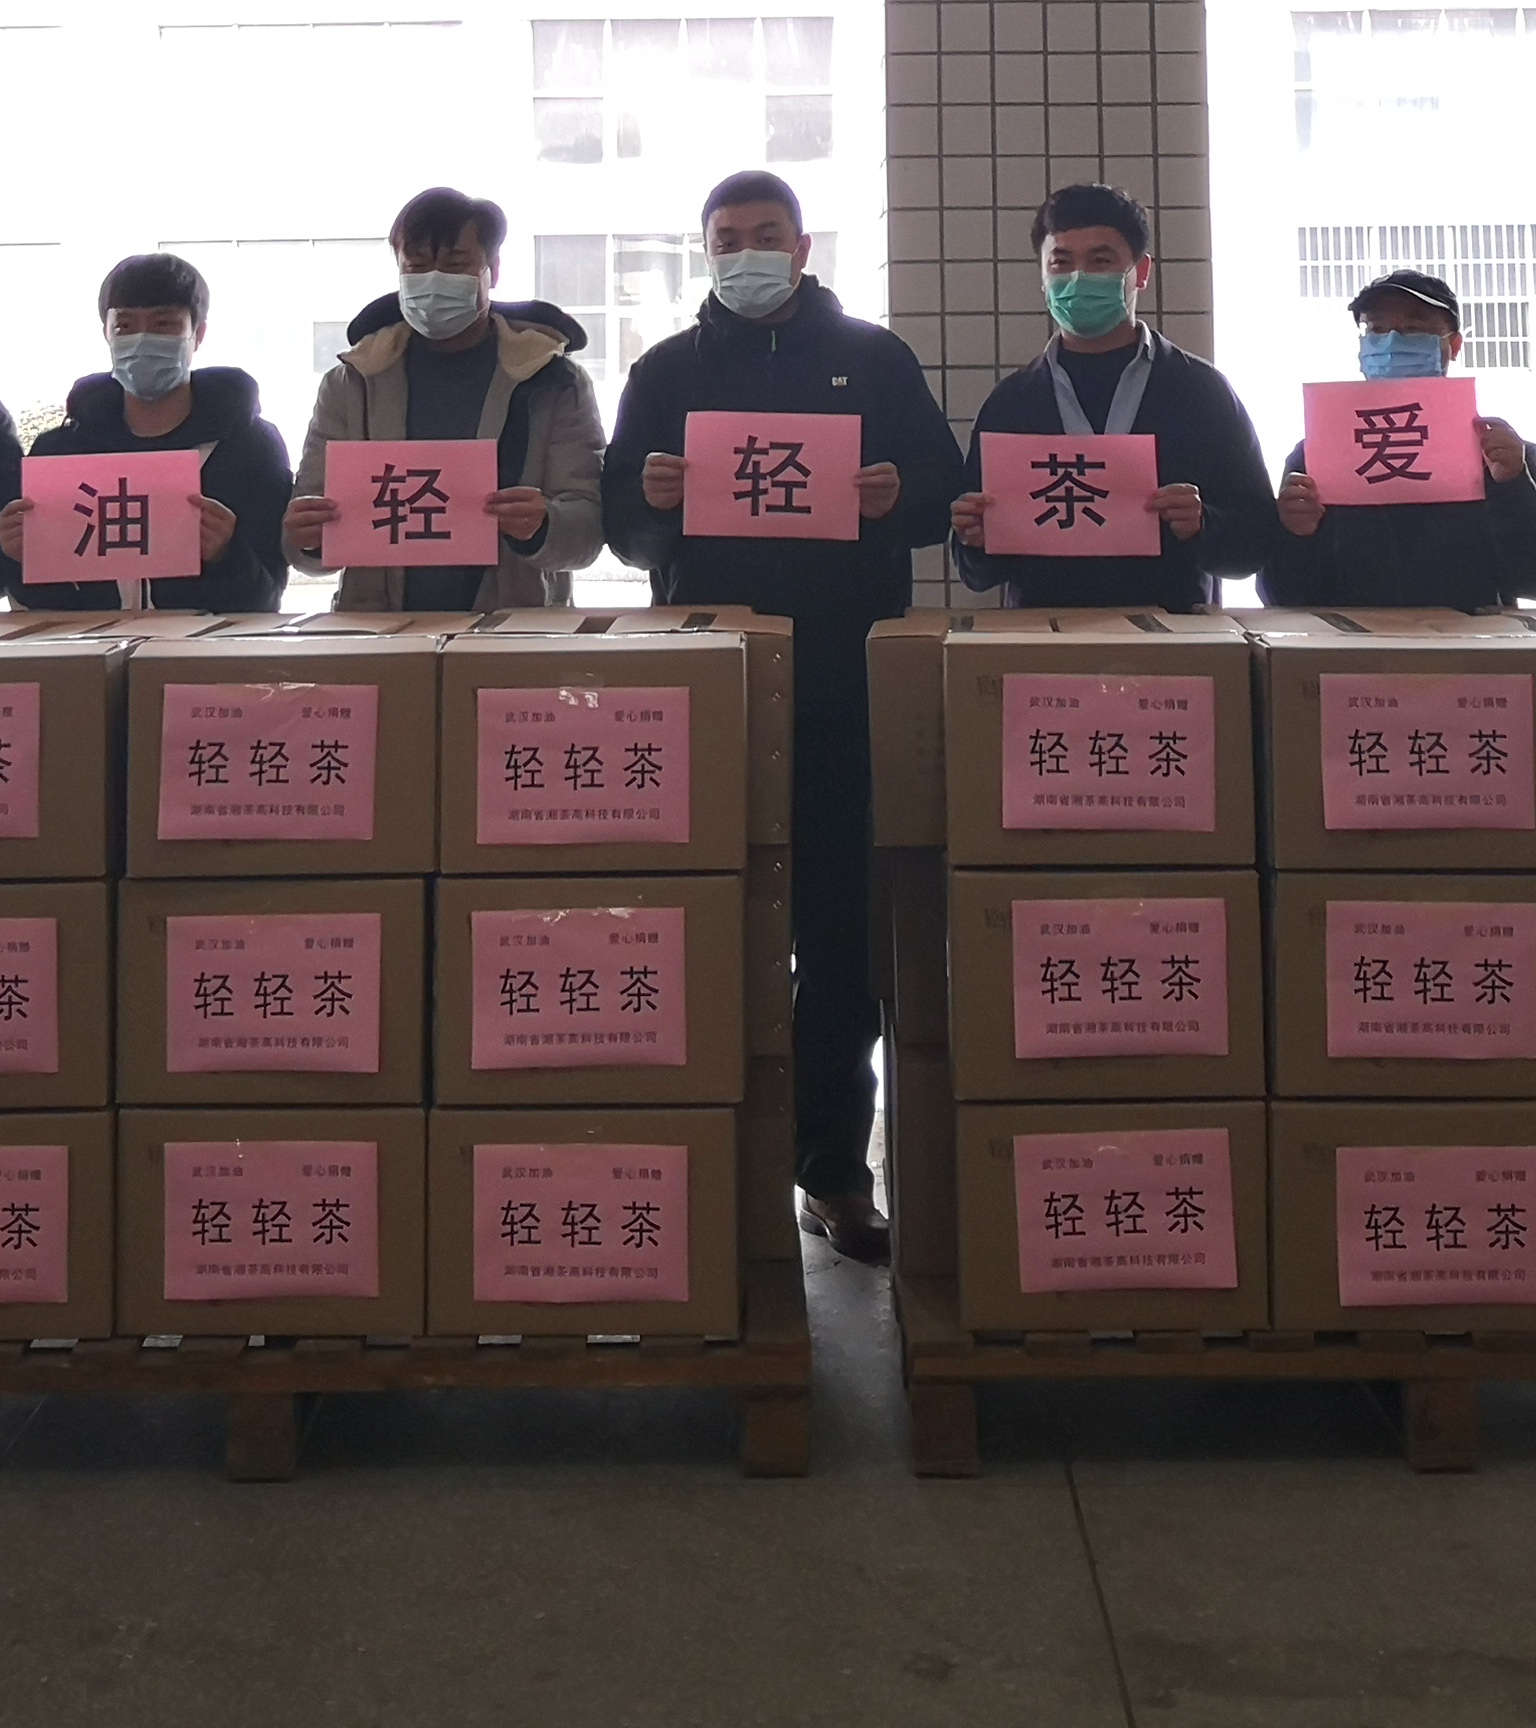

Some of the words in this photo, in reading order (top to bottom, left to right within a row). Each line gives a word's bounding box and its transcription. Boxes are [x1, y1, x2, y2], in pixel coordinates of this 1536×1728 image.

[831, 376, 849, 386] CAT
[1353, 402, 1433, 485] 爱
[732, 434, 812, 517] 轻
[1029, 452, 1111, 530] 茶
[73, 477, 150, 558] 油
[371, 463, 452, 545] 轻
[187, 738, 349, 787] 轻轻茶
[503, 742, 663, 792] 轻轻茶
[1028, 728, 1188, 778] 轻轻茶
[1347, 728, 1509, 777] 轻轻茶
[193, 970, 353, 1020] 轻轻茶
[499, 965, 659, 1016] 轻轻茶
[1039, 954, 1202, 1005] 轻轻茶
[1353, 955, 1514, 1005] 轻轻茶
[191, 1197, 351, 1246] 轻轻茶
[500, 1199, 662, 1249] 轻轻茶
[1043, 1185, 1206, 1240] 轻轻茶
[1363, 1202, 1528, 1252] 轻轻茶
